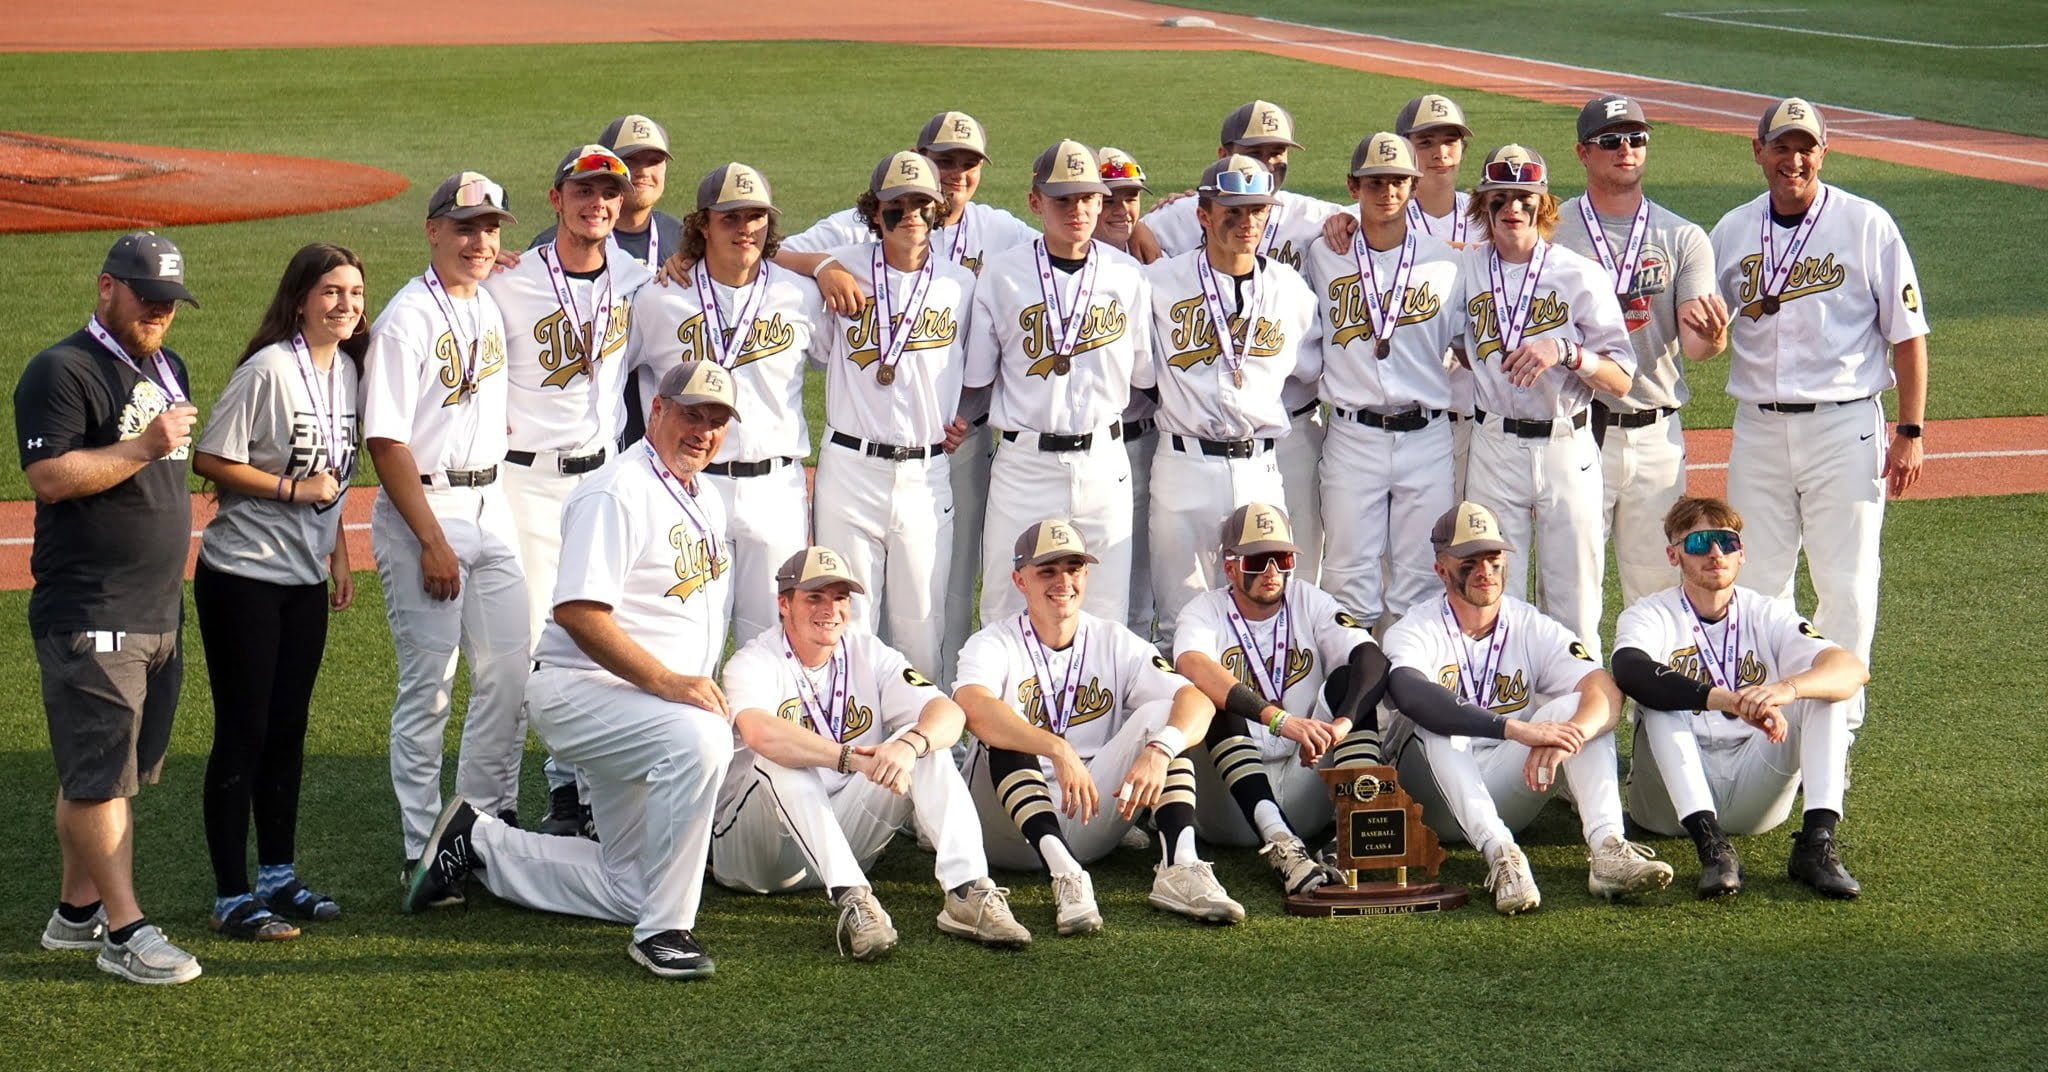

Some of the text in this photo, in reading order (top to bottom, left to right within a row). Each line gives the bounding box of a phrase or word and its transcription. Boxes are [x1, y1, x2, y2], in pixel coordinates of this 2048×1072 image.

[1603, 99, 1629, 119] E
[1379, 139, 1398, 162] ES
[900, 159, 920, 181] ES
[1066, 152, 1085, 176] ES
[158, 253, 182, 277] E
[1739, 252, 1845, 323] Ters
[1256, 512, 1275, 536] ES
[1367, 816, 1388, 824] STATE
[1361, 829, 1395, 838] BASEBALL
[1365, 843, 1386, 851] CLASS
[1359, 904, 1416, 916] THIRD PLACE
